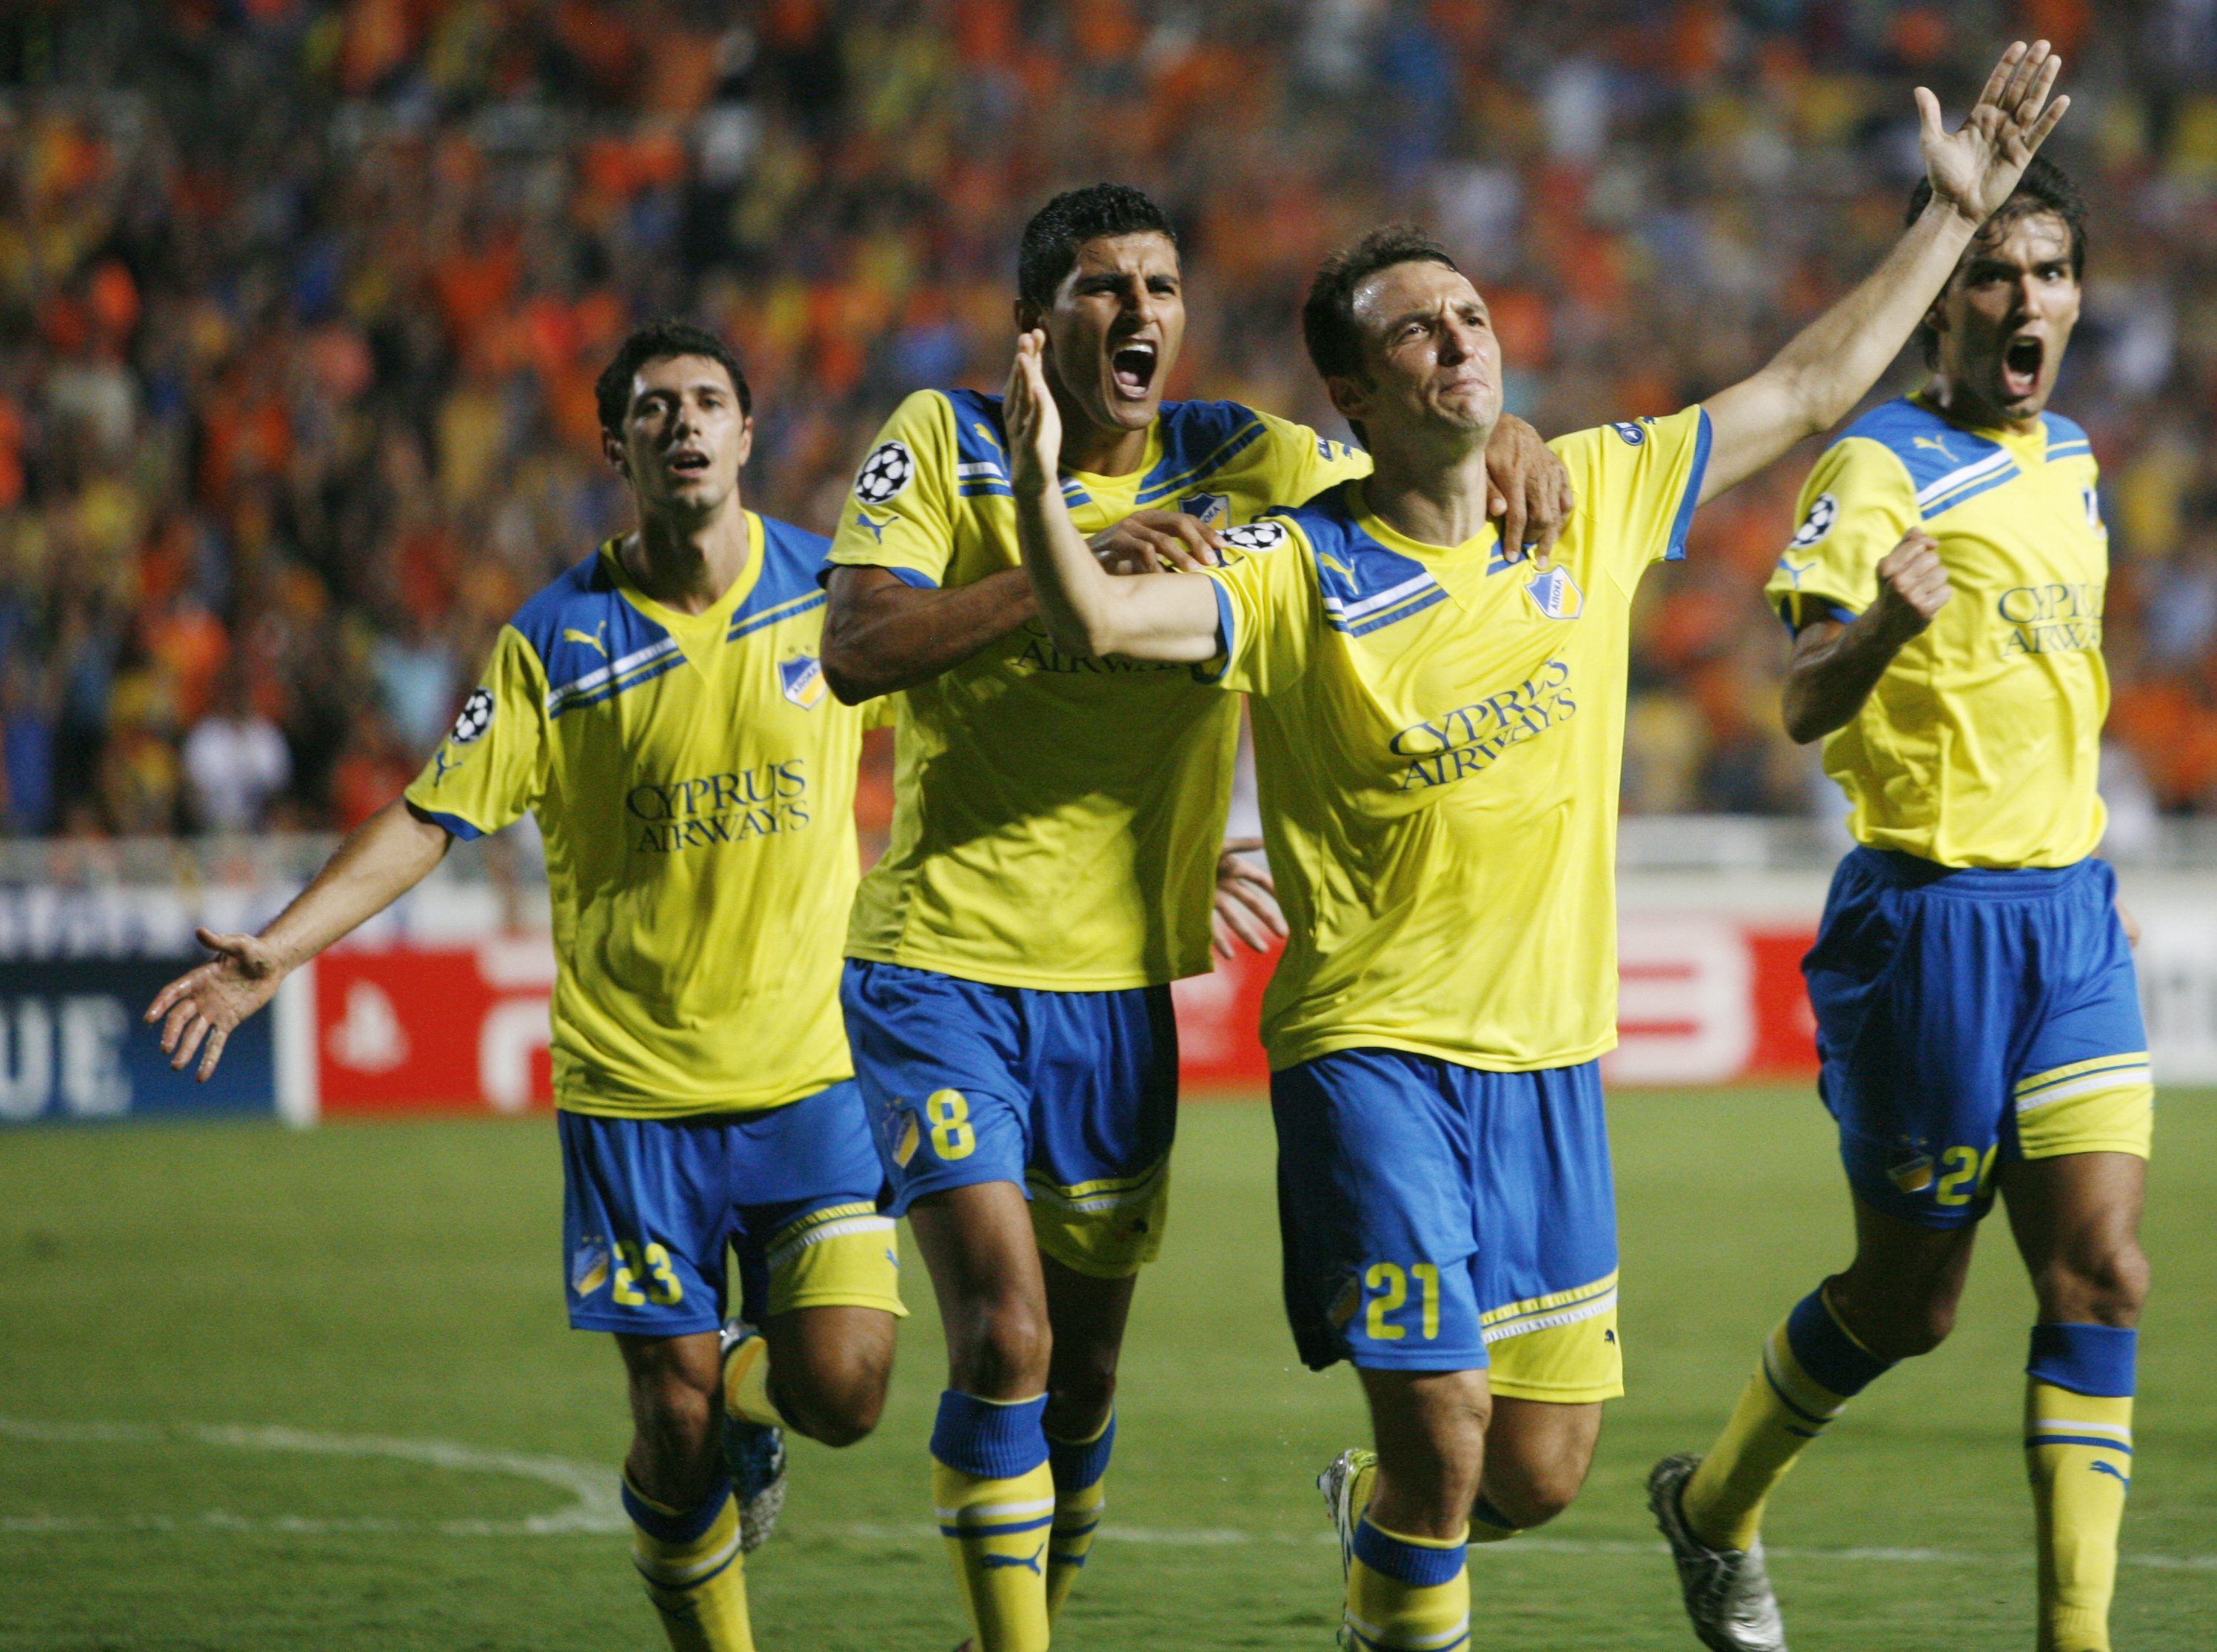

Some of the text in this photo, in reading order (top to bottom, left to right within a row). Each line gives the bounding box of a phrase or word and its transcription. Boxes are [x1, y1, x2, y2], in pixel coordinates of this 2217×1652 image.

[1998, 583, 2104, 623] CYPU
[1011, 639, 1180, 674] AIRW
[2002, 623, 2101, 656] AIRW
[626, 759, 806, 821] CYPRUS
[638, 800, 809, 853] AIRWAYS
[926, 1088, 976, 1161] 8
[612, 1240, 683, 1307] 23
[1365, 1262, 1439, 1340] 21
